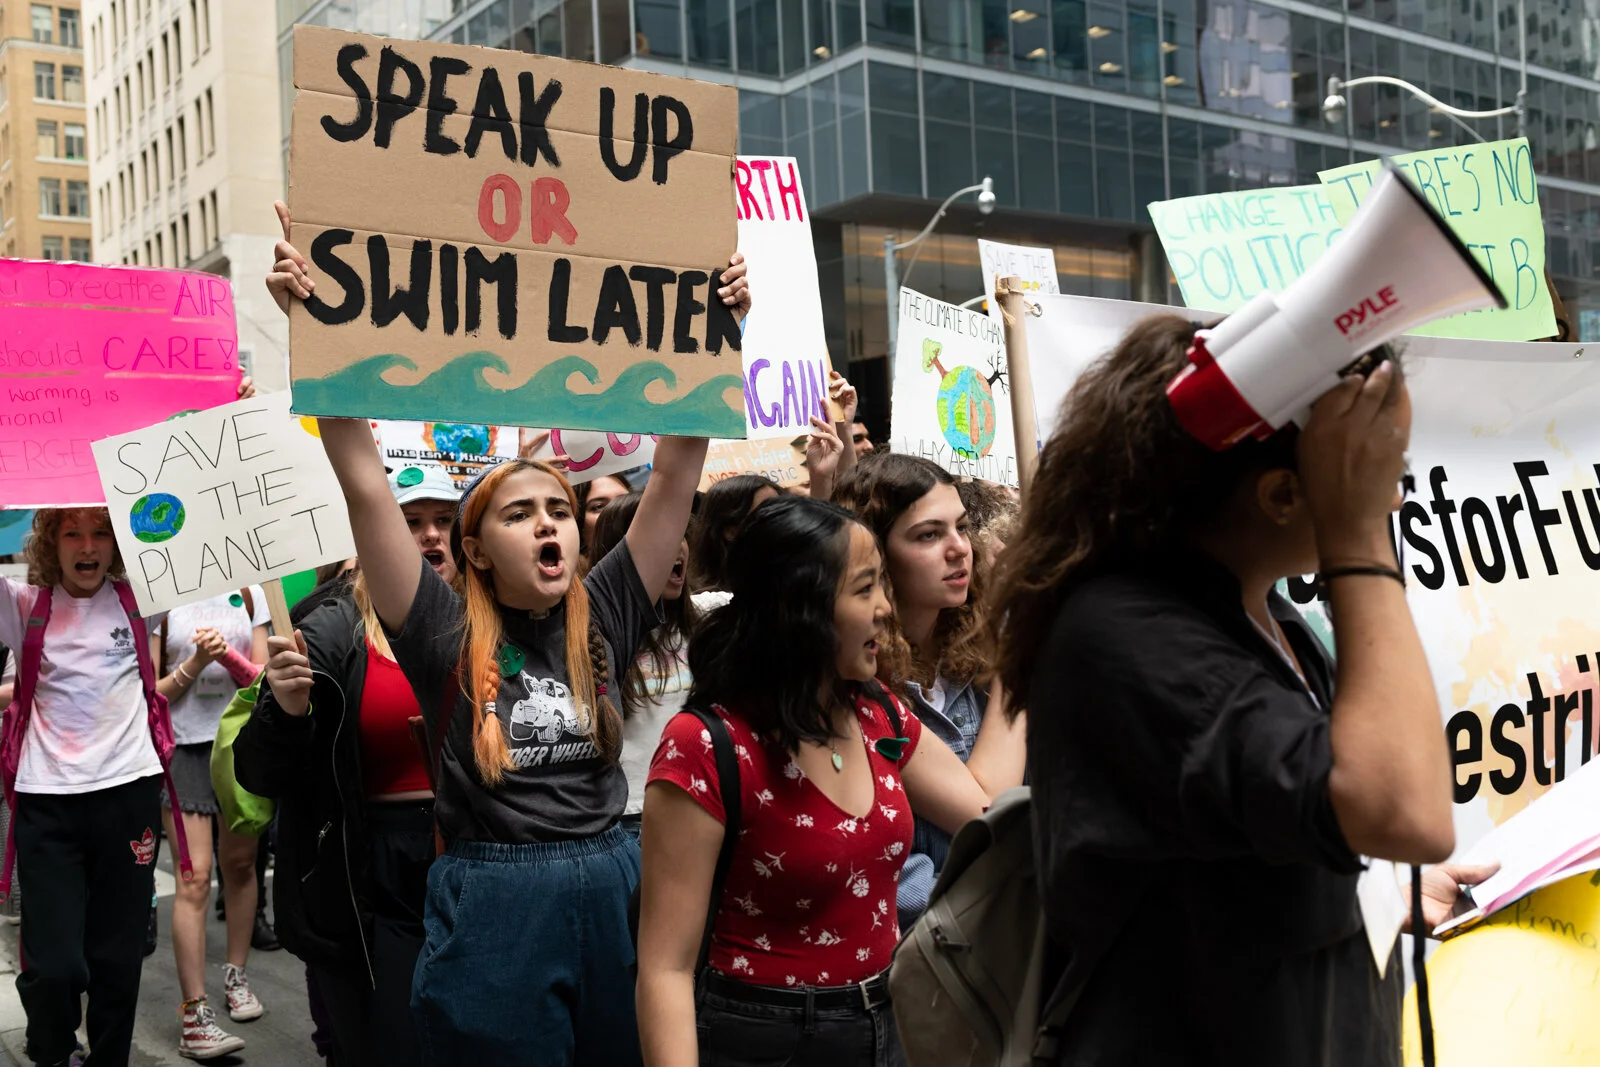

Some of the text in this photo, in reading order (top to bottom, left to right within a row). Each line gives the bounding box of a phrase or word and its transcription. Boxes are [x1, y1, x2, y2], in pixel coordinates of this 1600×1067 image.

[320, 43, 693, 185] SPEAK UP
[477, 173, 578, 246] OR
[735, 160, 804, 222] RTH
[1327, 144, 1535, 219] TRE'S NO
[1160, 195, 1285, 240] CHANGE
[47, 270, 166, 300] breathe
[173, 276, 231, 317] AIR
[303, 229, 742, 356] SWIM LATER
[1022, 253, 1050, 279] THE
[1168, 228, 1342, 306] POLITIC
[1510, 237, 1538, 310] B
[902, 290, 1006, 345] THE CLIMATE IS CHAN
[103, 336, 235, 371] CARE!
[9, 387, 120, 406] Warming is
[0, 439, 92, 474] ERGE
[113, 409, 275, 495] SAVE
[198, 467, 297, 520] THE
[138, 504, 329, 602] PLANET
